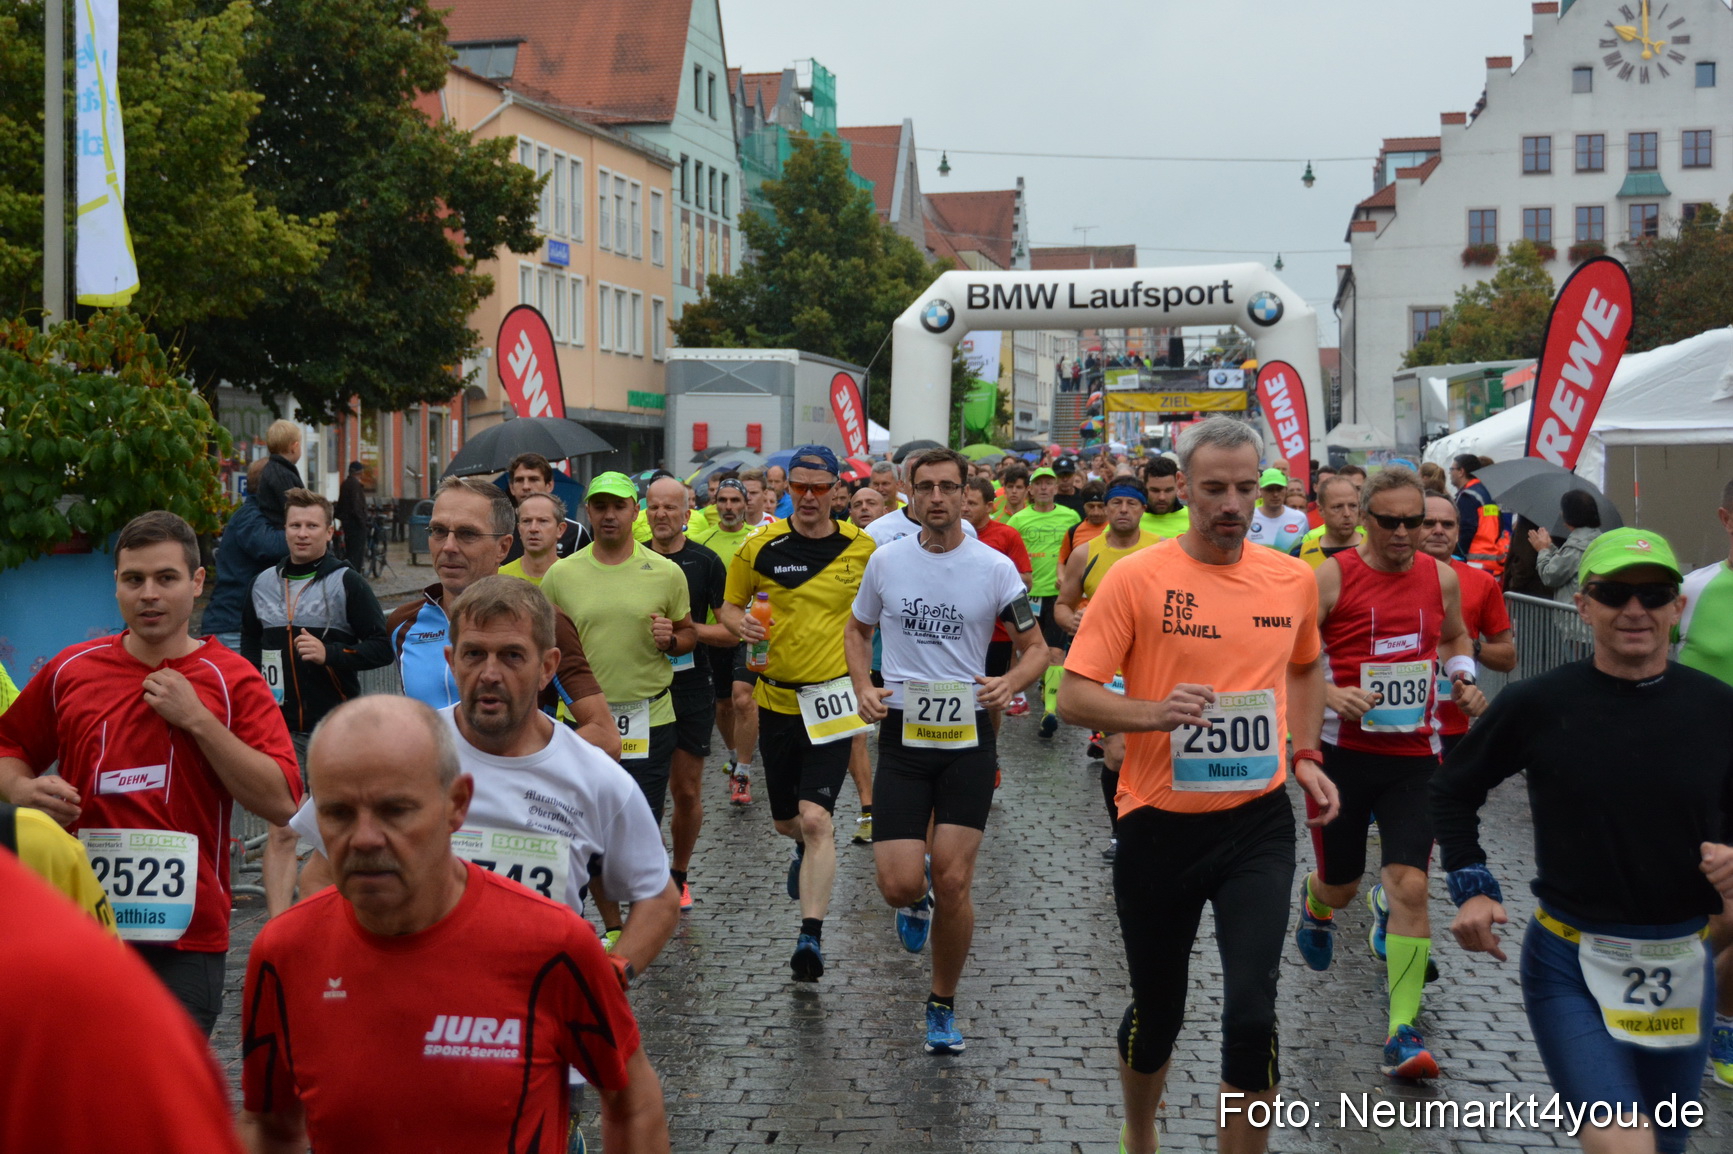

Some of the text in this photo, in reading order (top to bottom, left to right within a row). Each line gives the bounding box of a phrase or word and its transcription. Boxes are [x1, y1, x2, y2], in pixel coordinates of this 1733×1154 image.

[966, 279, 1234, 312] BMW Laufsport
[1536, 287, 1619, 468] REWE
[1161, 396, 1192, 408] ZIEL
[774, 564, 808, 574] Markus
[1166, 589, 1199, 608] FÖR
[901, 598, 957, 621] Sport
[1163, 604, 1193, 621] DIG
[904, 618, 960, 633] Müller
[1252, 616, 1292, 628] THULE
[1386, 640, 1407, 649] DEHN
[1219, 693, 1267, 707] BOCK
[1370, 678, 1427, 706] 3038
[814, 691, 854, 719] 601
[918, 697, 962, 722] 272
[917, 728, 963, 739] Alexander
[1183, 714, 1270, 753] 2500
[1208, 763, 1248, 777] Muris
[118, 773, 148, 786] DEHN
[129, 833, 188, 849] BOCK
[491, 833, 558, 855] BOCK
[91, 857, 185, 897] 2523
[113, 908, 166, 924] atthias
[1640, 941, 1694, 956] BOCK
[1622, 966, 1672, 1007] 23
[425, 1015, 520, 1044] JURA
[1644, 1017, 1685, 1032] Xaver
[424, 1044, 519, 1059] SPORT-Service
